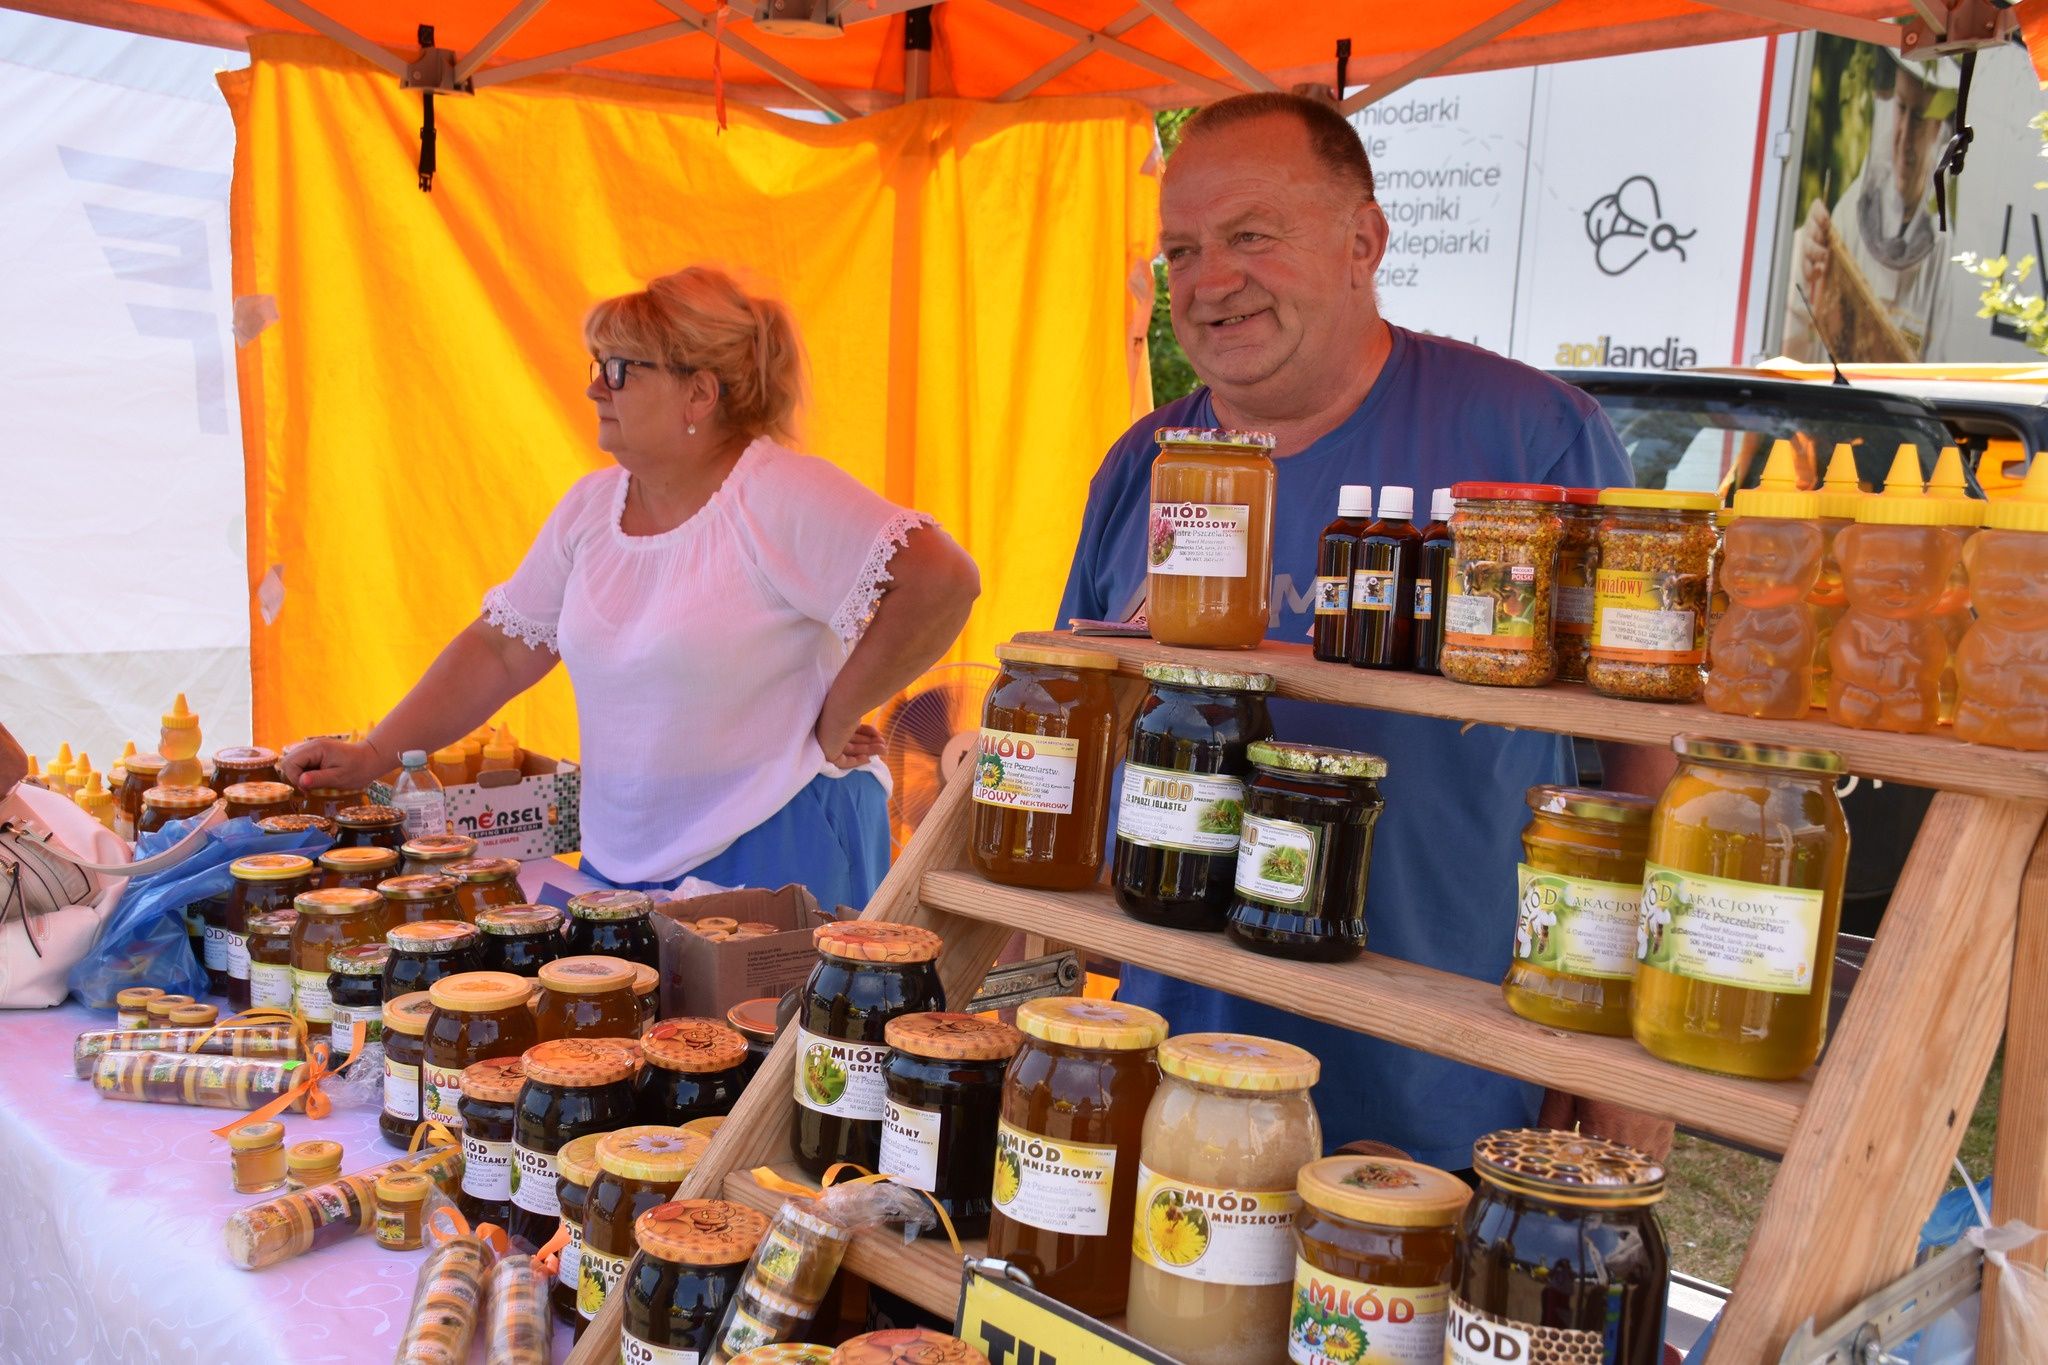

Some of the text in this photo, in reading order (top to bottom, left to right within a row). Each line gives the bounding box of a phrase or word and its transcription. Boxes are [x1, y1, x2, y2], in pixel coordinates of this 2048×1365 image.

[1366, 135, 1387, 158] le
[1374, 161, 1502, 190] emownice
[1381, 196, 1461, 227] stojniki
[1388, 228, 1491, 259] klepiarki
[1374, 262, 1420, 288] zież
[1555, 335, 1698, 371] apilandia
[1161, 503, 1208, 519] MIÓD
[1174, 520, 1237, 529] WRZOSOWY
[980, 733, 1036, 760] MIÓD
[975, 786, 1069, 810] LIPOWY NEKTAROWY
[1143, 776, 1194, 802] MIÓD
[1131, 795, 1150, 806] SPADZI
[1152, 799, 1187, 812] IGLASTEJ
[458, 807, 543, 831] MERSEL
[1688, 893, 1779, 916] AKACJOWY
[850, 1063, 881, 1073] GRYC
[885, 1101, 900, 1121] ÓD
[464, 1139, 488, 1155] IÓD
[514, 1147, 548, 1168] MIÓD
[1008, 1134, 1061, 1162] MIÓD
[522, 1164, 561, 1178] GRYCZAN
[1022, 1158, 1102, 1180] MNISZKOWY
[1185, 1190, 1258, 1212] MIÓD
[1211, 1212, 1295, 1225] MNISZKOWY
[593, 1256, 626, 1275] MIÓ
[1309, 1277, 1415, 1324] MIÓD
